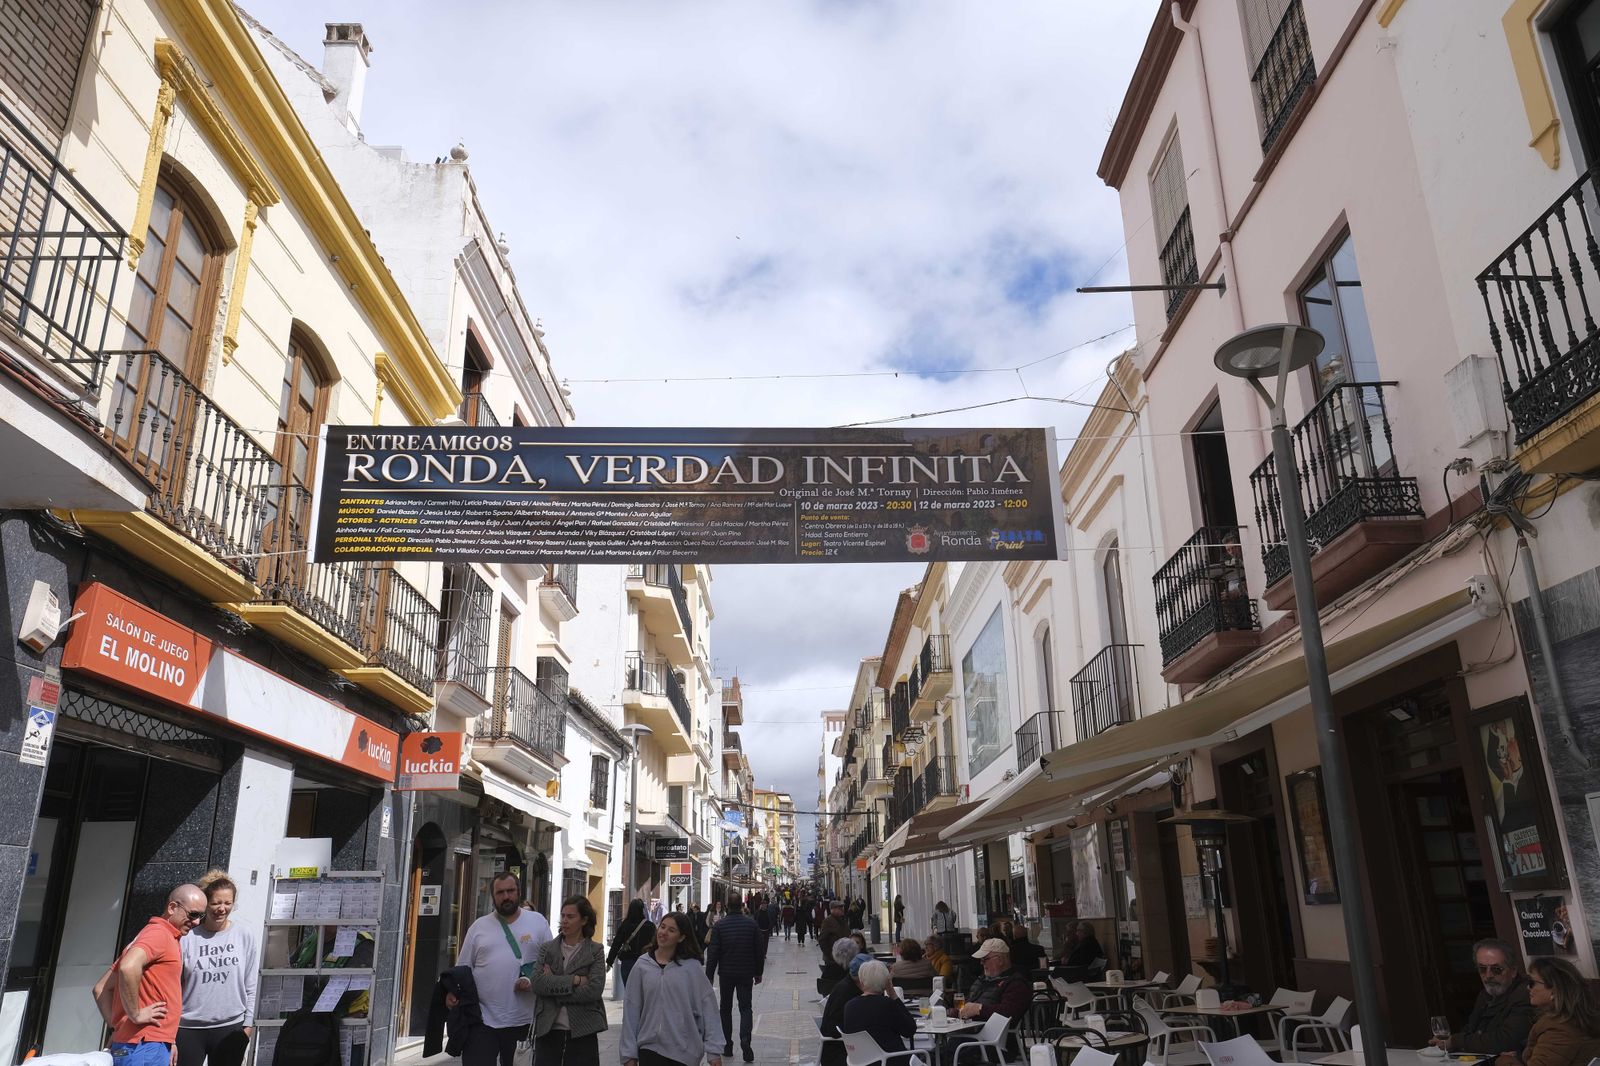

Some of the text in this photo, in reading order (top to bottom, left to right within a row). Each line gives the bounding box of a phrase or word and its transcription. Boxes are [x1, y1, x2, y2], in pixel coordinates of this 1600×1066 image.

[346, 434, 512, 451] ENTREAMIGOS
[343, 453, 1031, 490] RONDA, VERDAD INFINITA
[780, 488, 819, 499] Original
[835, 488, 855, 496] José
[877, 488, 911, 498] Tornay
[923, 488, 964, 496] Dirección:
[990, 487, 1023, 496] Jiménez
[801, 502, 811, 510] 10
[813, 502, 824, 510] de
[855, 501, 878, 510] 2023
[886, 501, 912, 510] 20:30
[920, 501, 929, 509] 12
[931, 501, 942, 509] de
[972, 500, 995, 509] 2023
[1003, 499, 1028, 508] 12:00
[942, 536, 982, 546] Ronda
[996, 540, 1025, 550] Print
[335, 545, 396, 553] COLABORACIÓN
[143, 631, 157, 647] DE
[158, 640, 189, 661] JUEGO
[99, 634, 185, 687] EL MOLINO
[367, 737, 392, 764] luckia
[405, 758, 453, 773] luckia
[1521, 911, 1544, 920] Churros
[1522, 929, 1551, 938] Chocolate
[199, 943, 234, 957] Have
[193, 955, 239, 971] A Nice
[201, 971, 230, 984] Day
